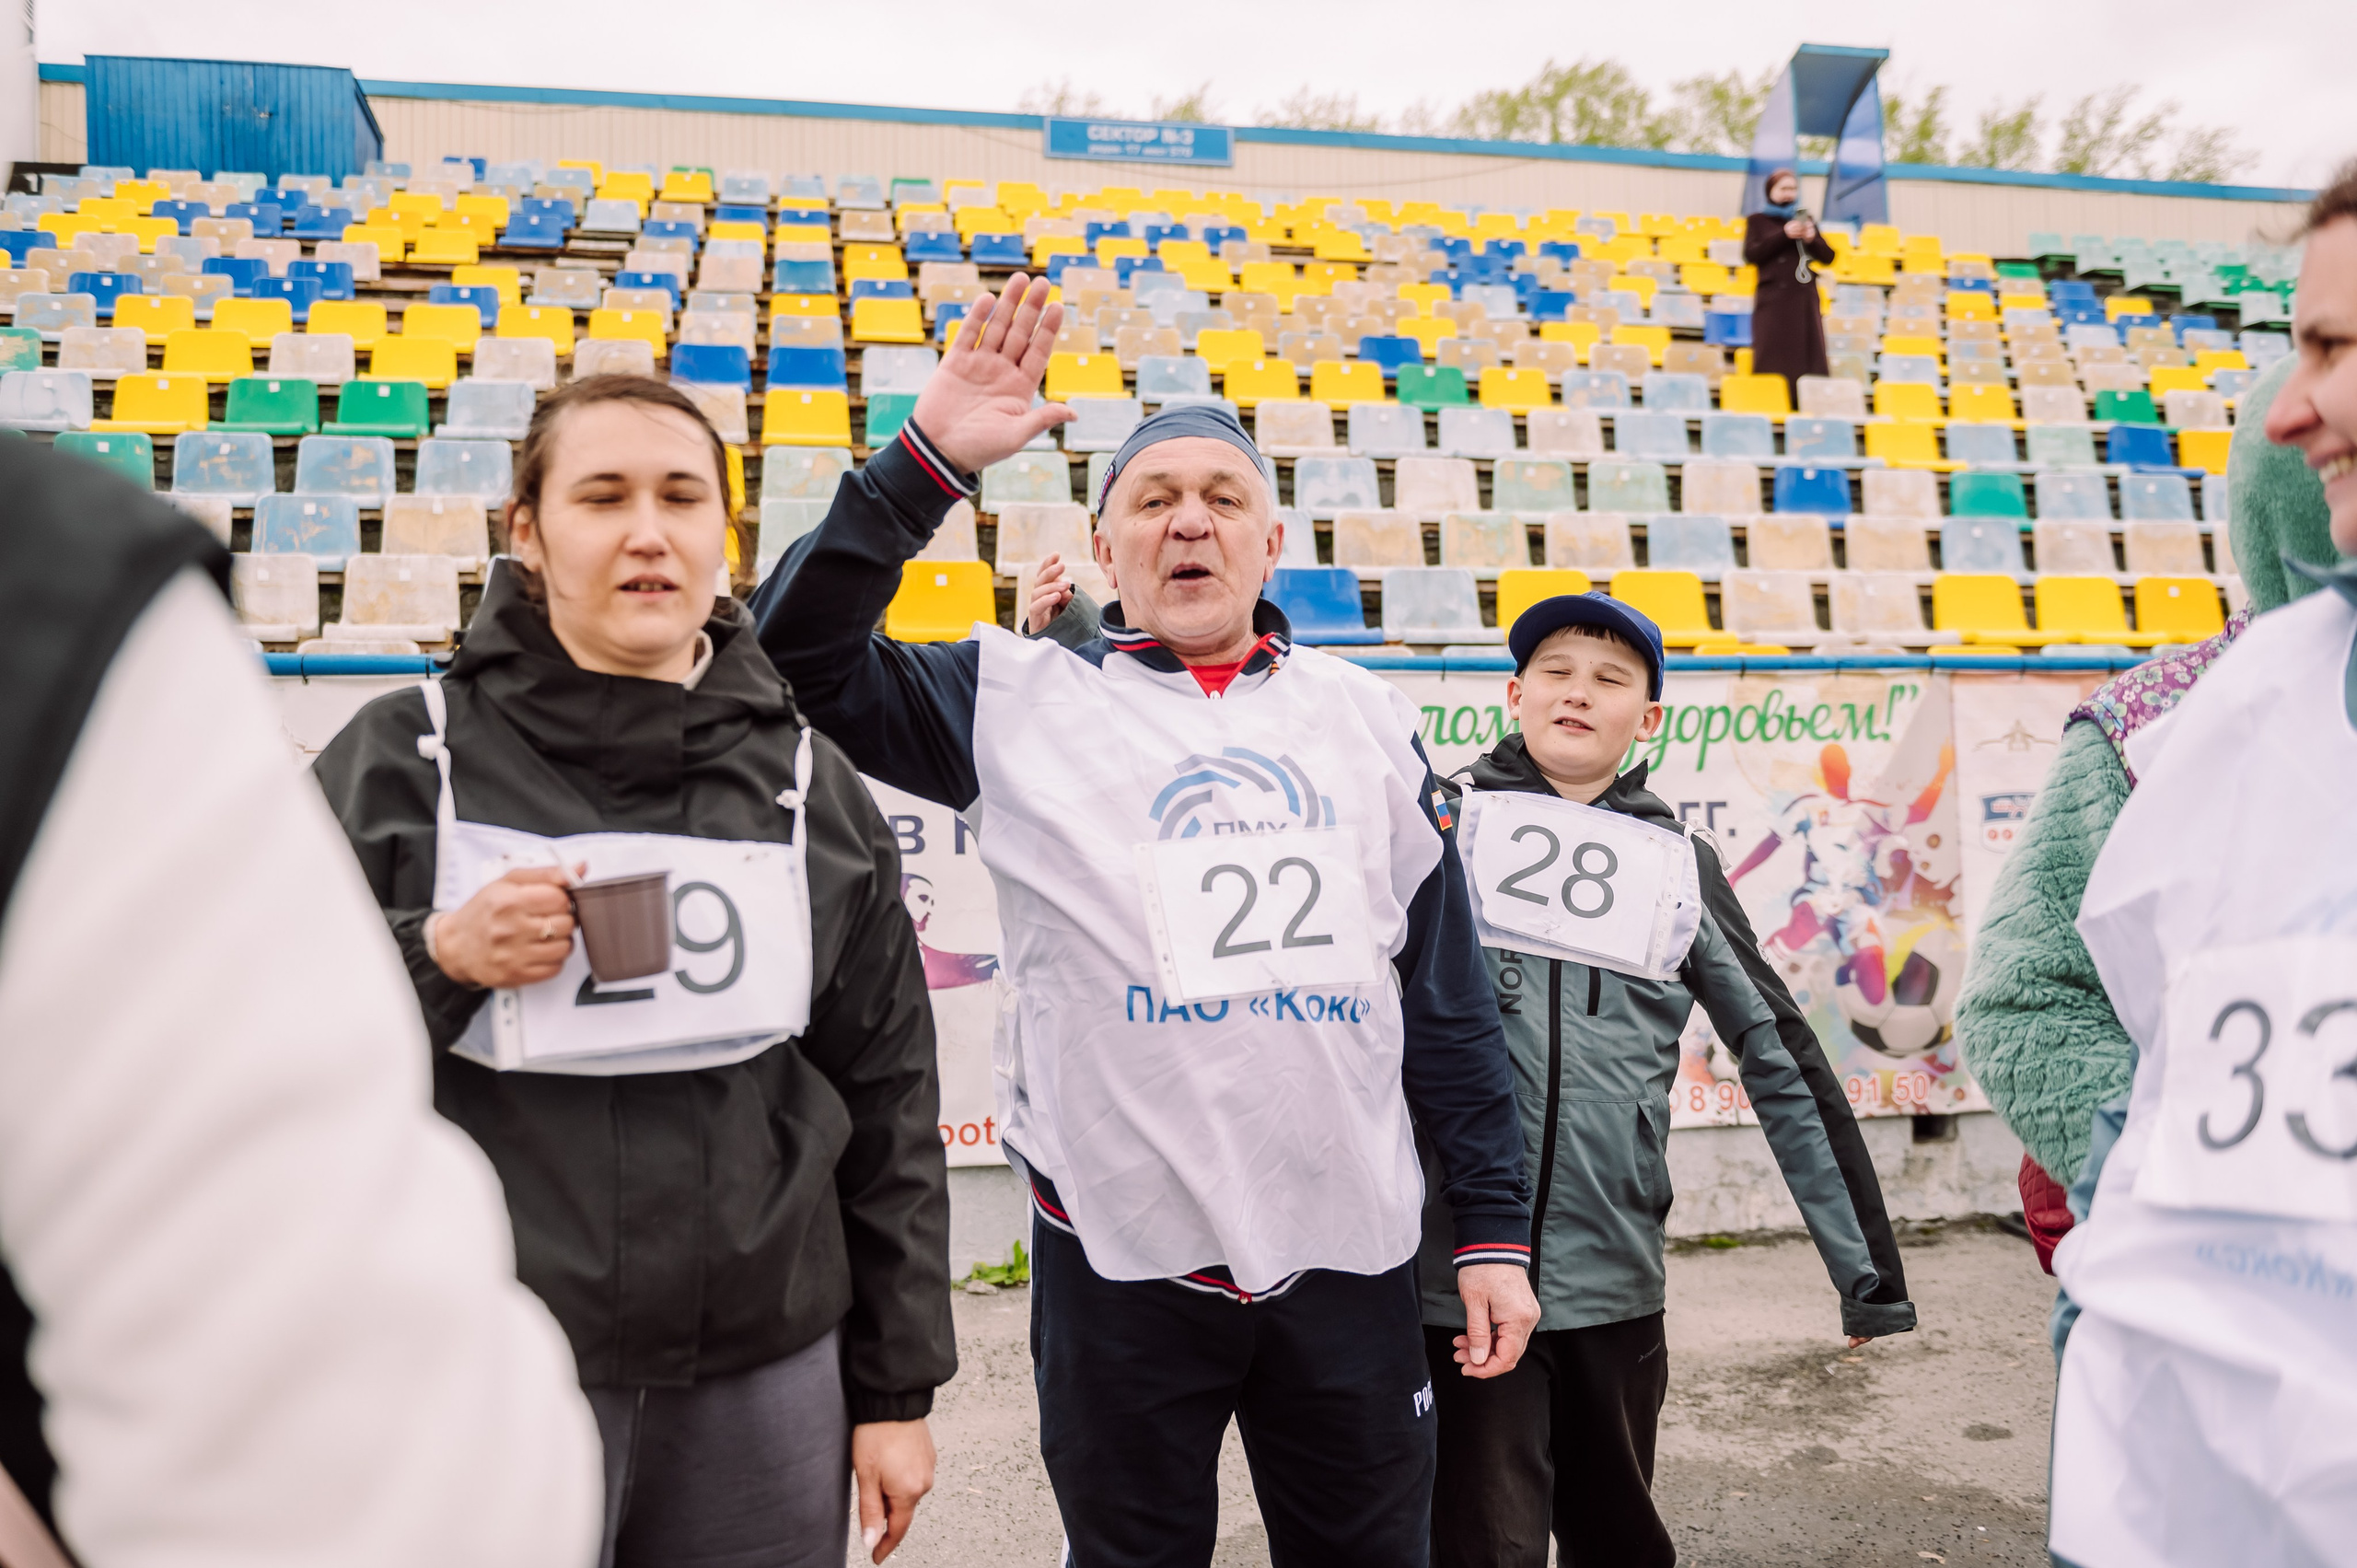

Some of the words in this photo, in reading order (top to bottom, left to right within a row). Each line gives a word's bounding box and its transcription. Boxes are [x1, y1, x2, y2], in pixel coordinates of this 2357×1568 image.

[1086, 124, 1159, 143] СЕКТОР
[1495, 824, 1619, 919] 28
[1201, 856, 1334, 959] 22
[1127, 985, 1229, 1023] ПАО
[1689, 1085, 1707, 1112] 8
[1847, 1074, 1881, 1104] 91
[1895, 1074, 1929, 1102] 50
[2198, 998, 2357, 1163] 33
